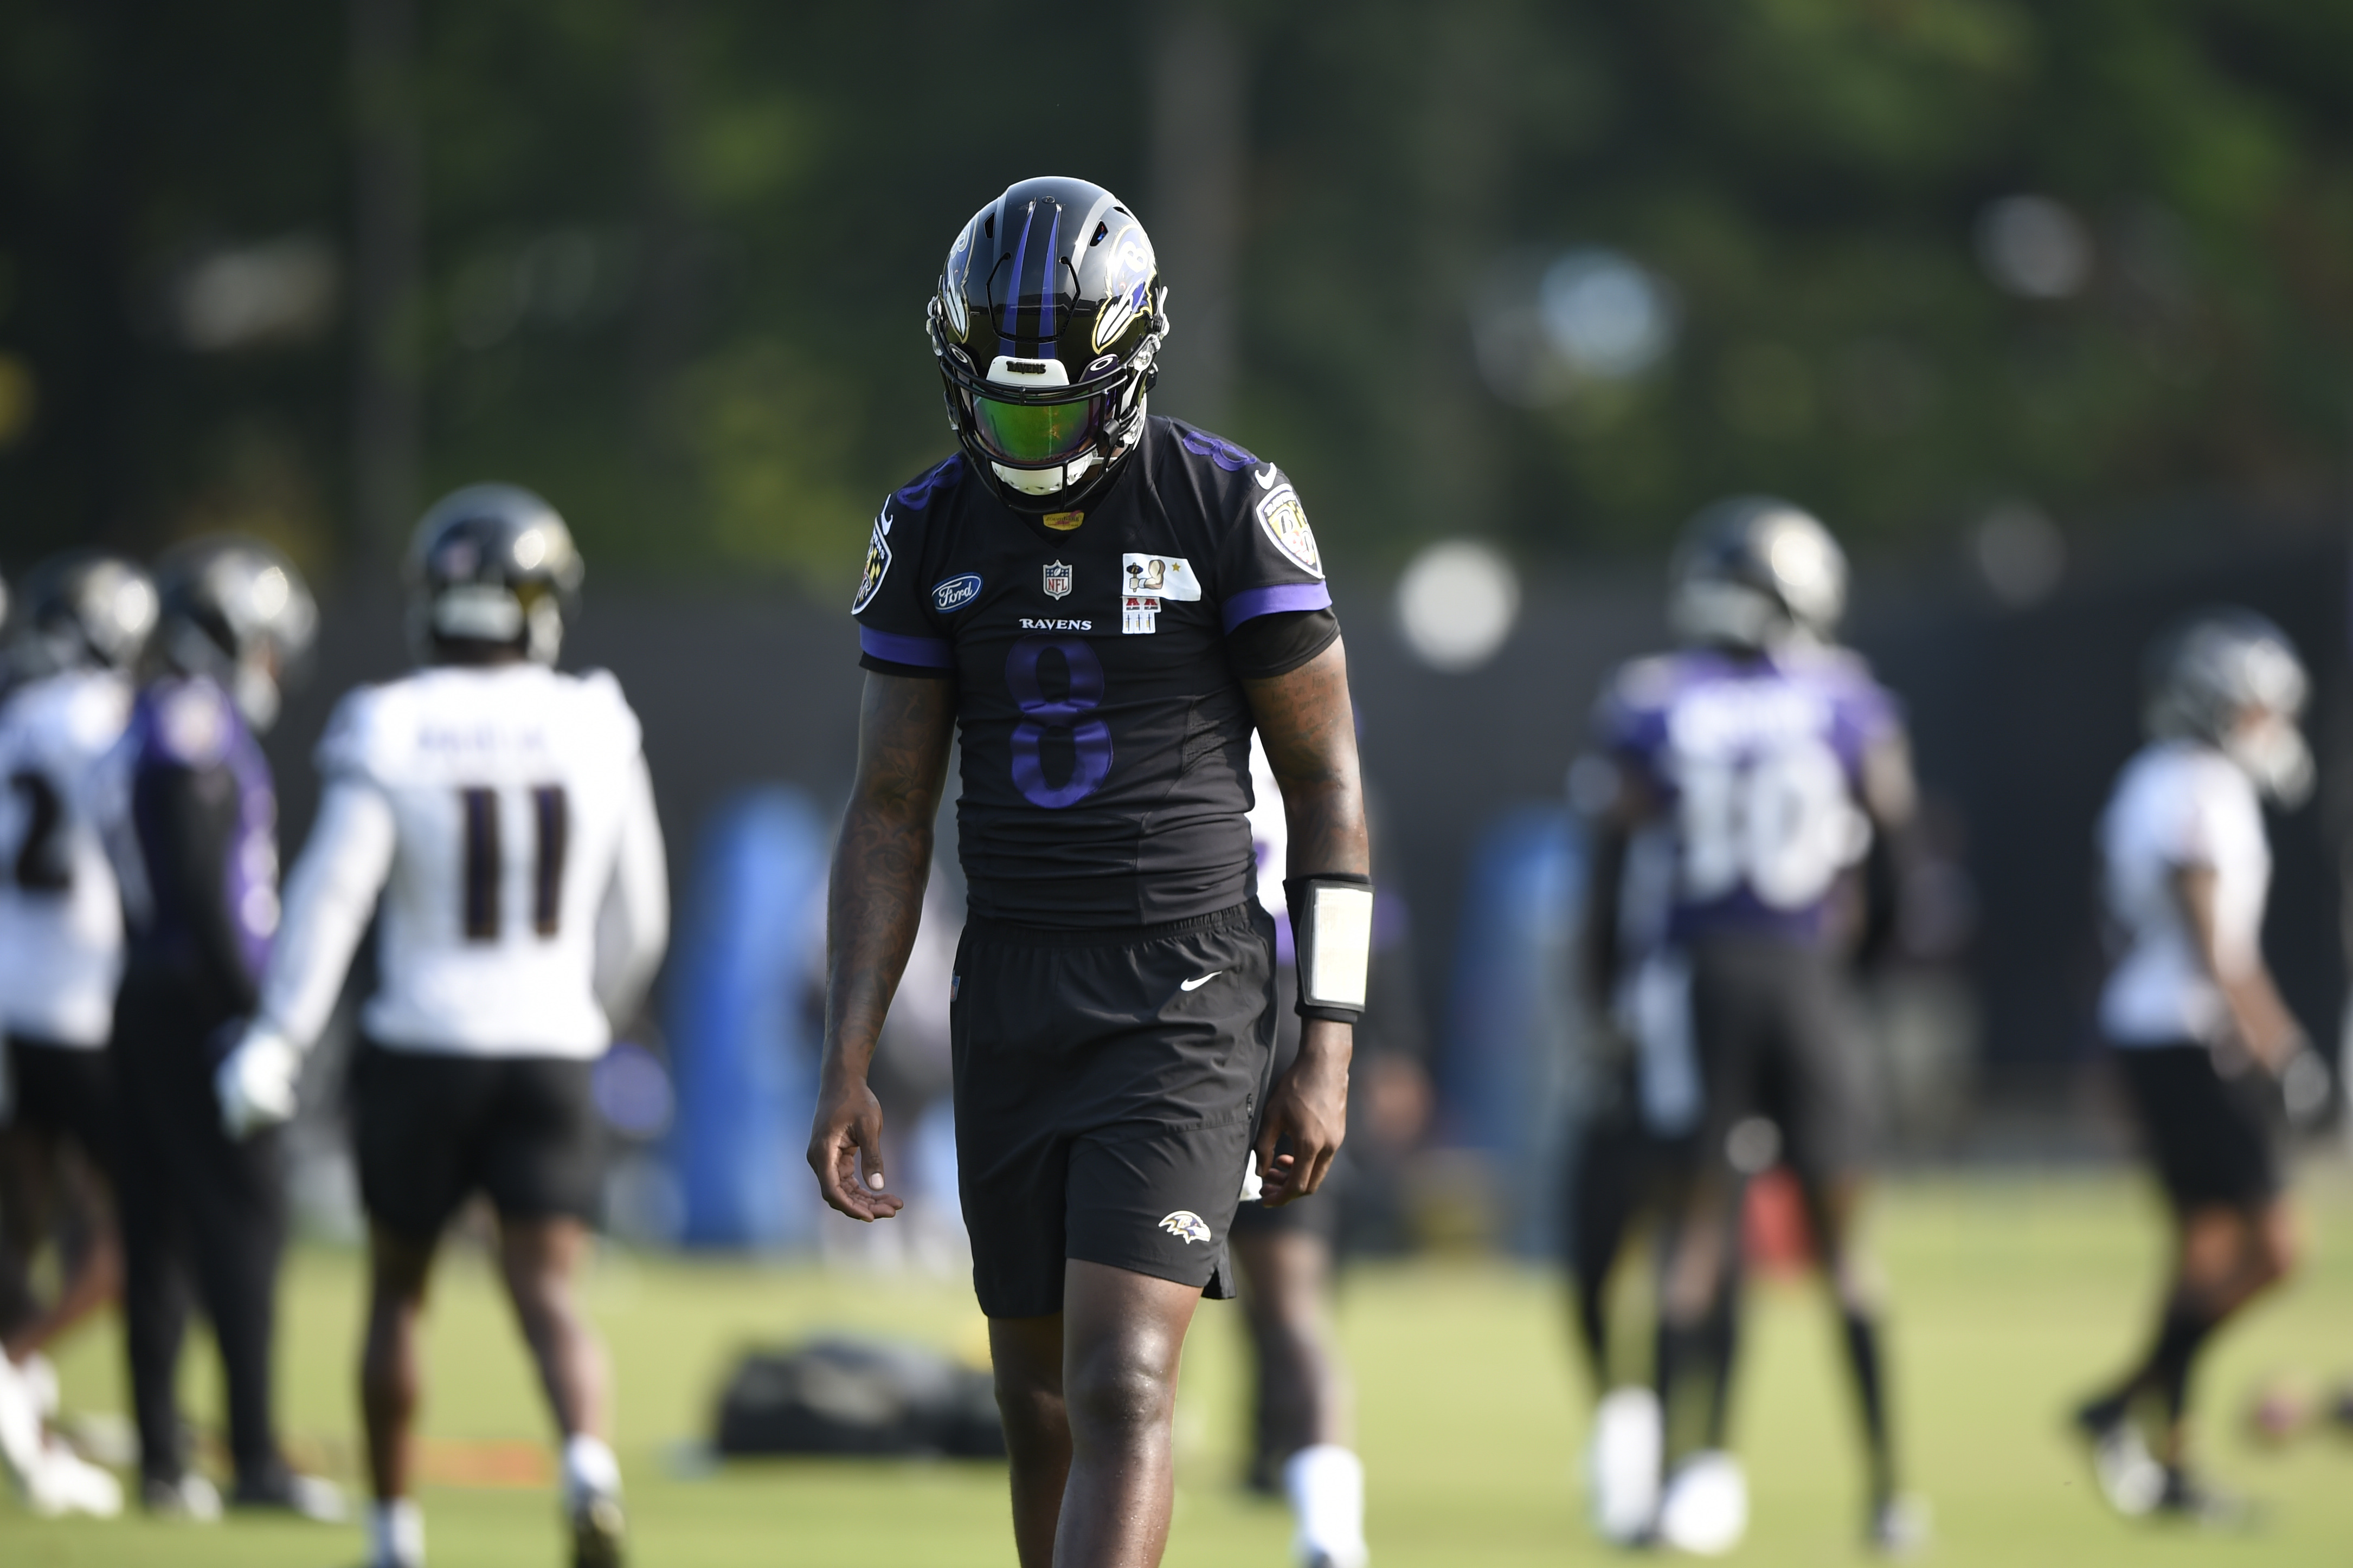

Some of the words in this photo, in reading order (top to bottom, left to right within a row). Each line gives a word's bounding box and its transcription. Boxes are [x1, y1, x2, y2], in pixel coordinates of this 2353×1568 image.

[1006, 360, 1046, 374] RAVENS
[1183, 431, 1257, 472] 8
[897, 455, 963, 511] 8
[938, 581, 973, 607] Ford
[1048, 578, 1067, 592] NFL
[1019, 618, 1092, 630] RAVENS
[1005, 633, 1114, 809] 8
[458, 785, 568, 942] 11
